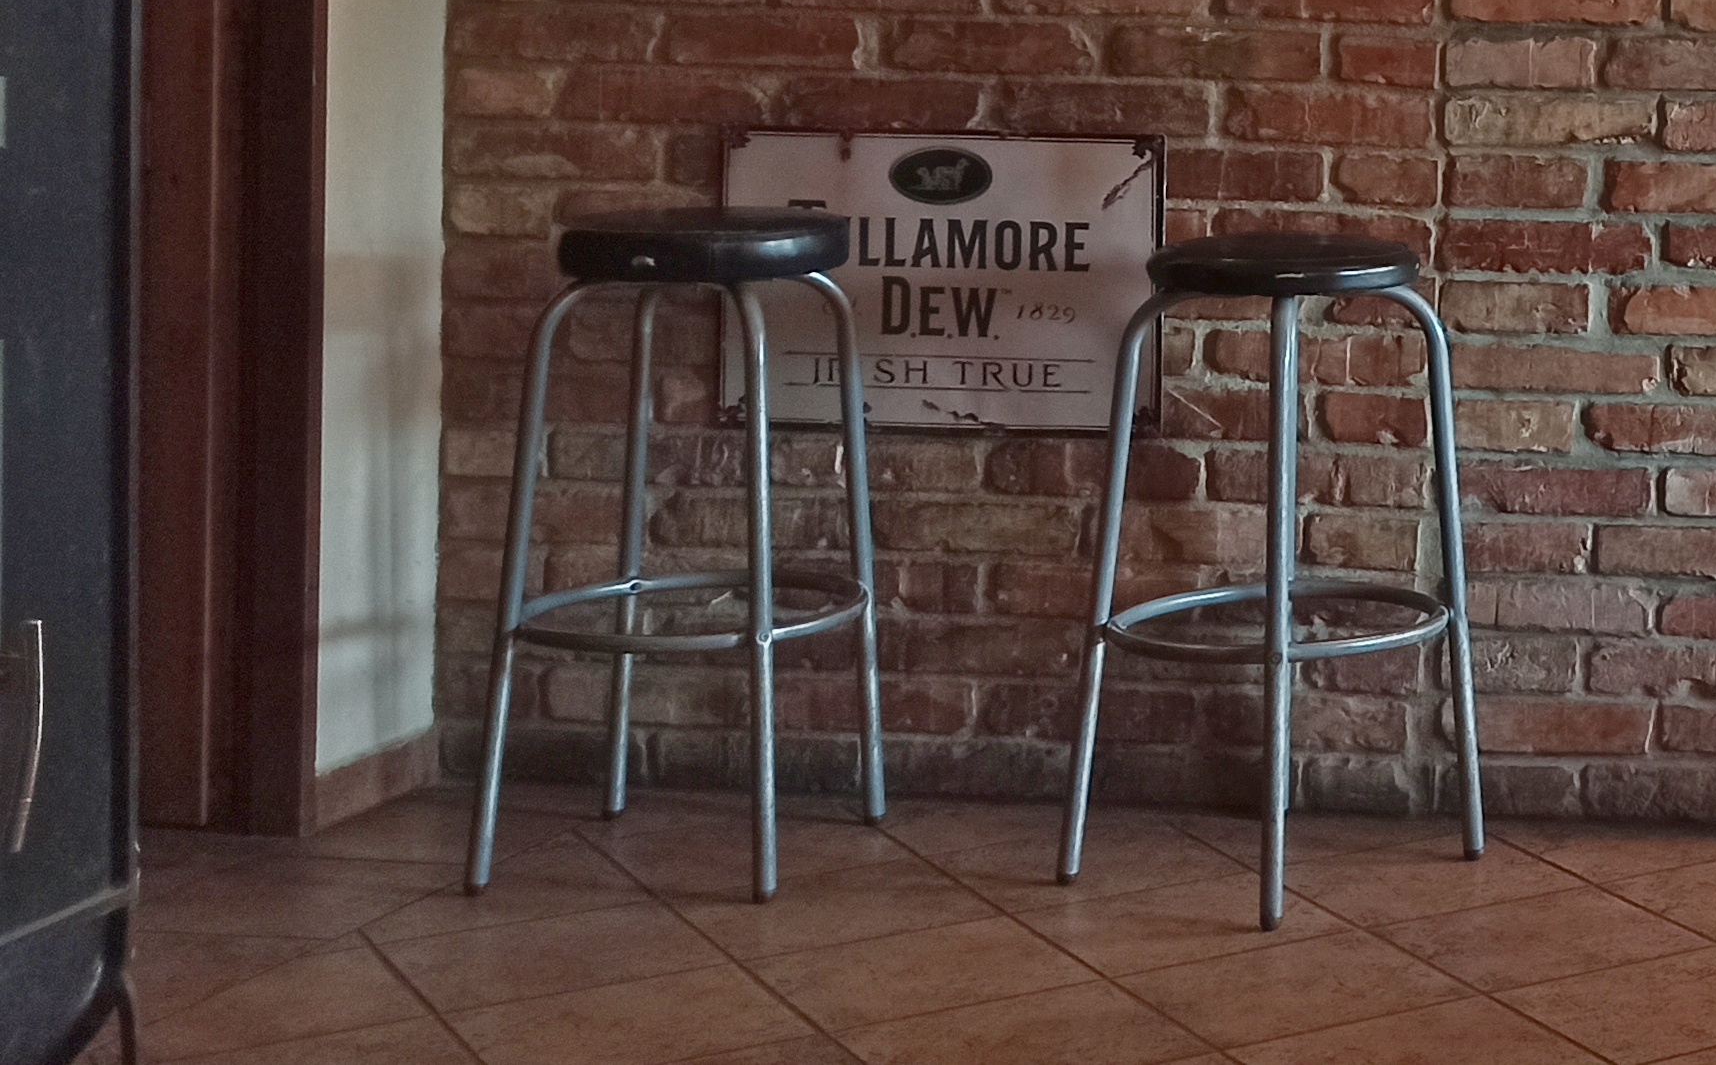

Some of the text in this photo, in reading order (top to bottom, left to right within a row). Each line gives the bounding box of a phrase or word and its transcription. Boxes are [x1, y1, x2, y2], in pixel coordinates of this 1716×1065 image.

[788, 199, 1091, 273] LLAMORE
[1016, 302, 1077, 325] 1829
[952, 360, 1063, 391] TRUE
